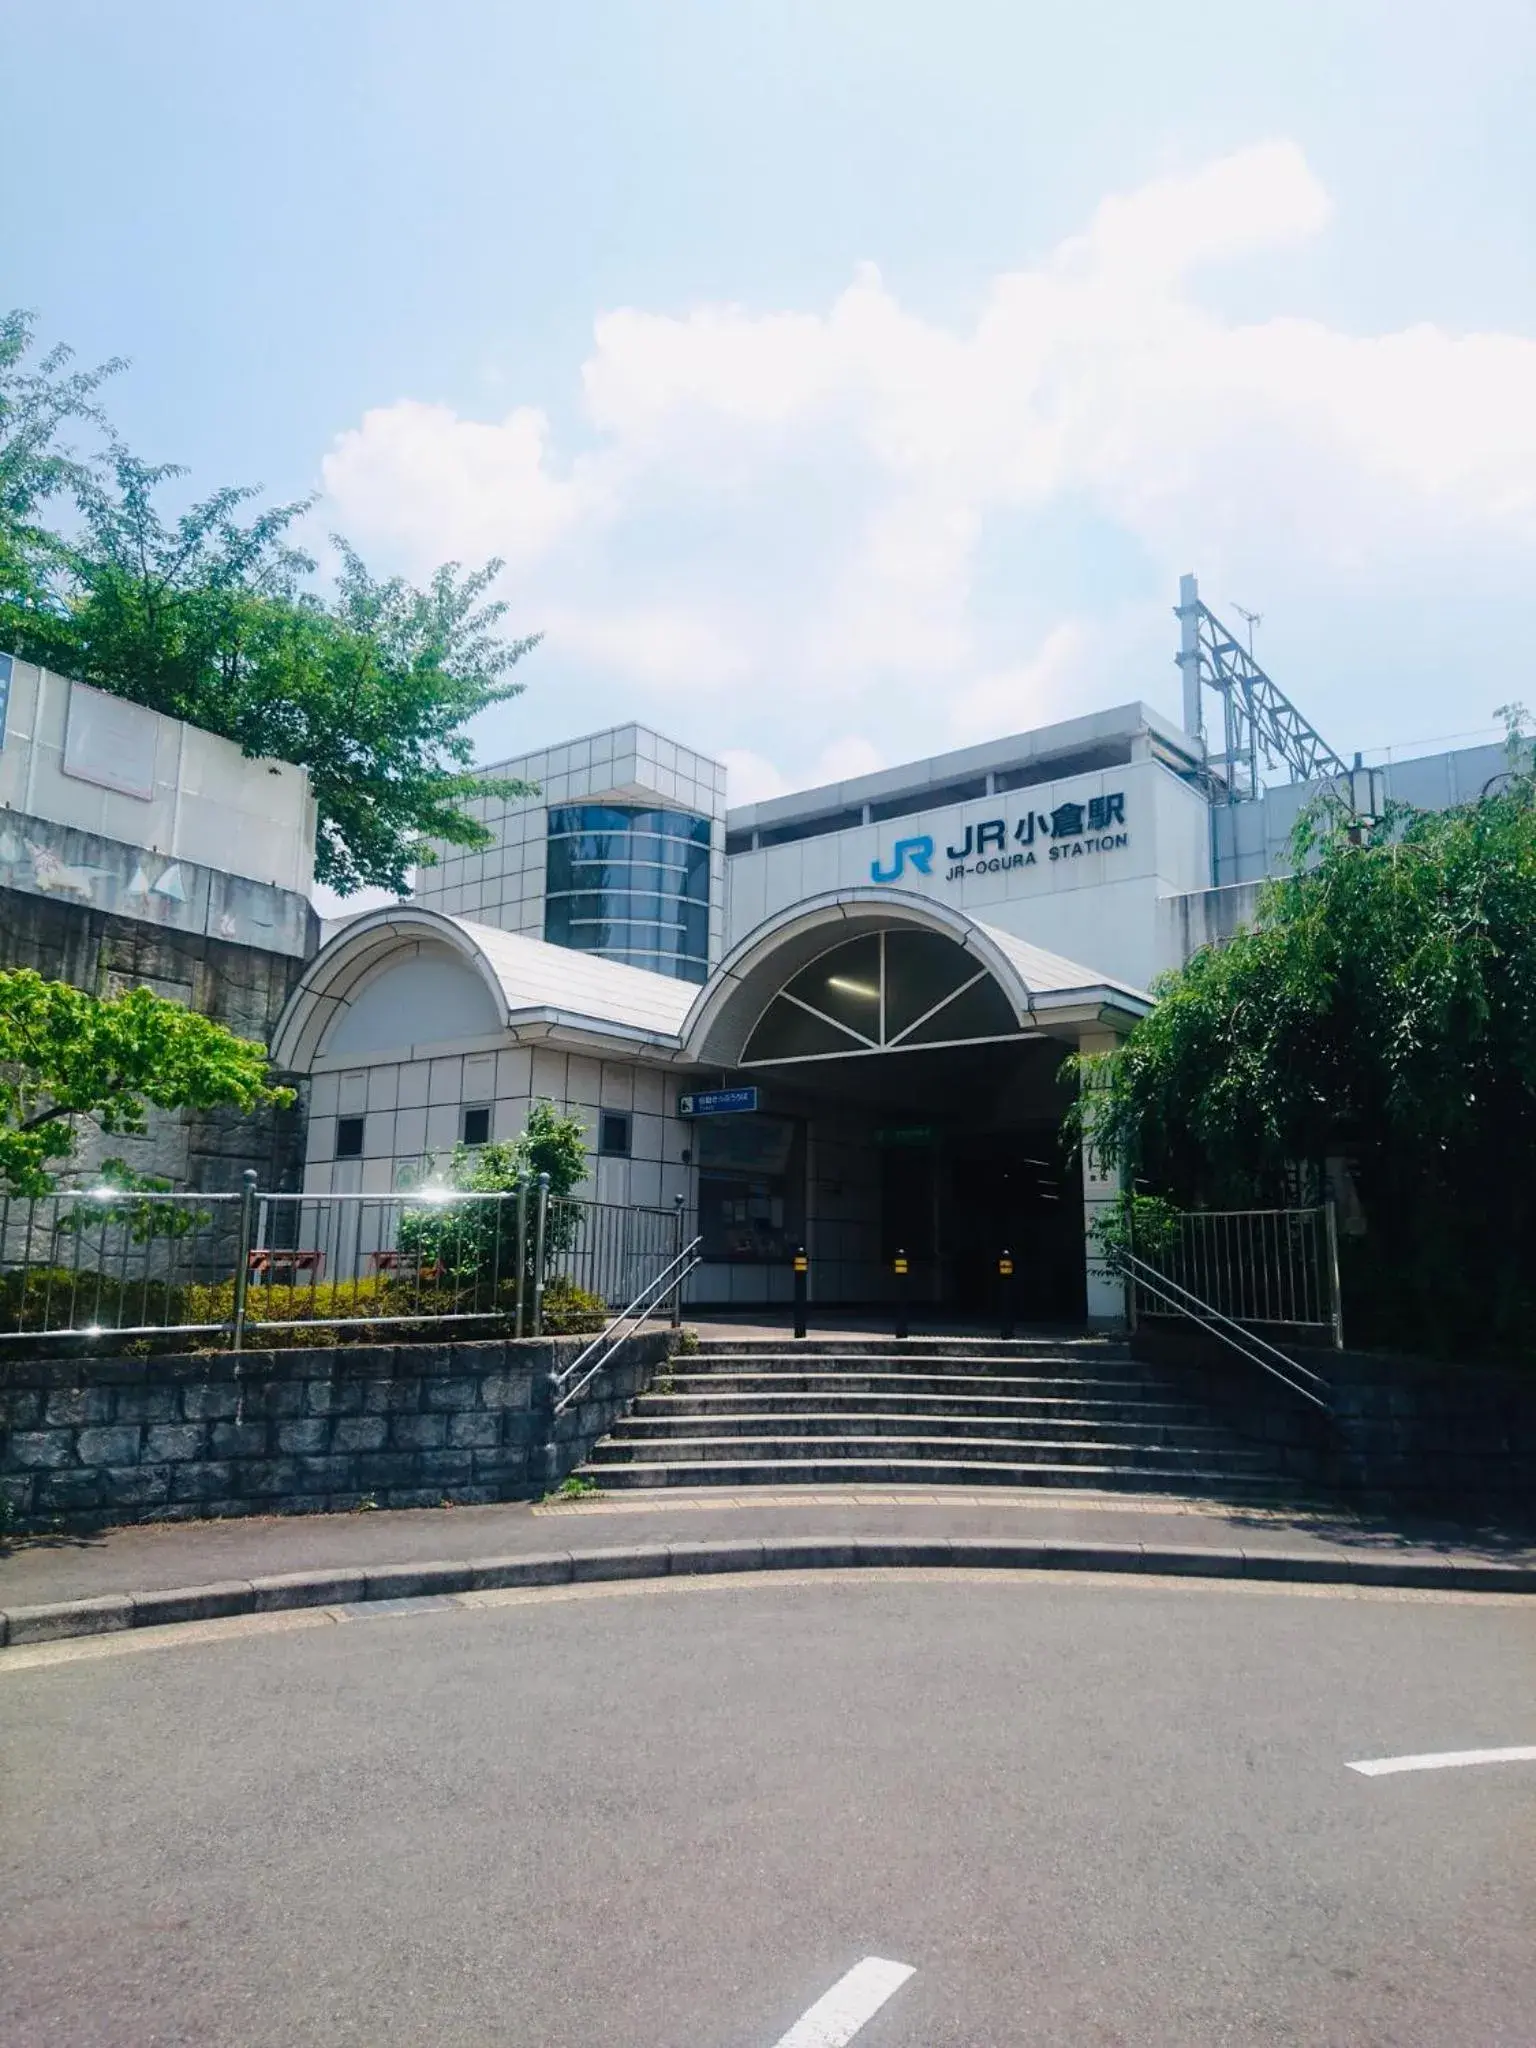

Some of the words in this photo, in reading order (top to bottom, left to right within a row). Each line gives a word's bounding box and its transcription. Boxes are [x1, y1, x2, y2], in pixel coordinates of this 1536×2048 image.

[871, 835, 934, 883] JR
[945, 851, 1037, 882] JR-OGURA
[1048, 833, 1128, 862] STATION
